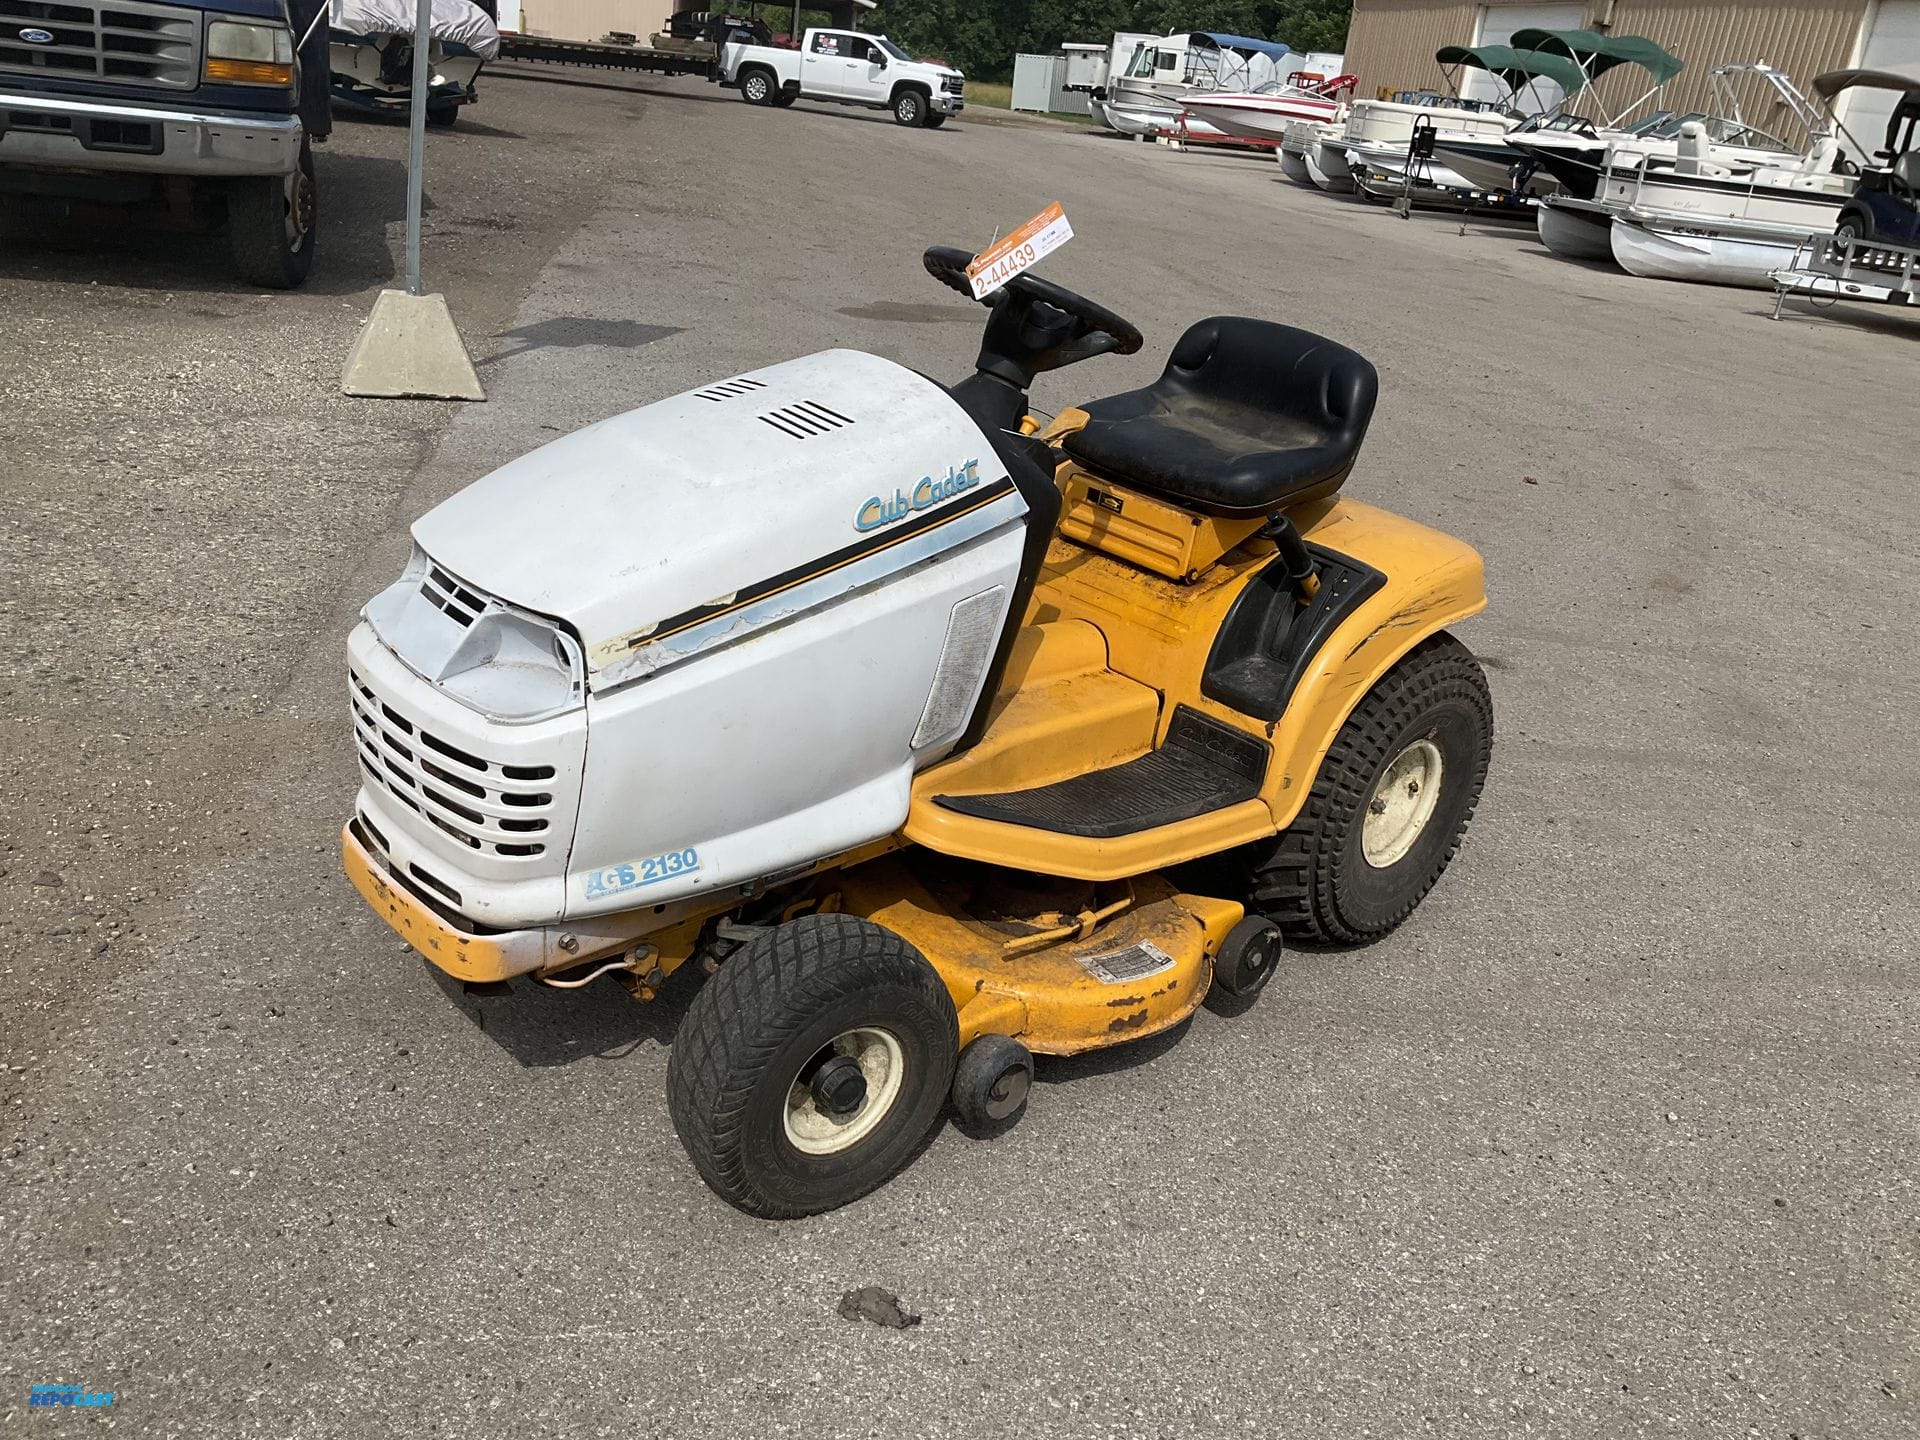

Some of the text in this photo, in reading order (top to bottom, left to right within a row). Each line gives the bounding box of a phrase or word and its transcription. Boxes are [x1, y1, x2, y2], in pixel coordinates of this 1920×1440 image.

[975, 243, 1036, 295] 2-44439
[854, 457, 979, 532] Cub Cadet
[641, 848, 698, 881] 2130
